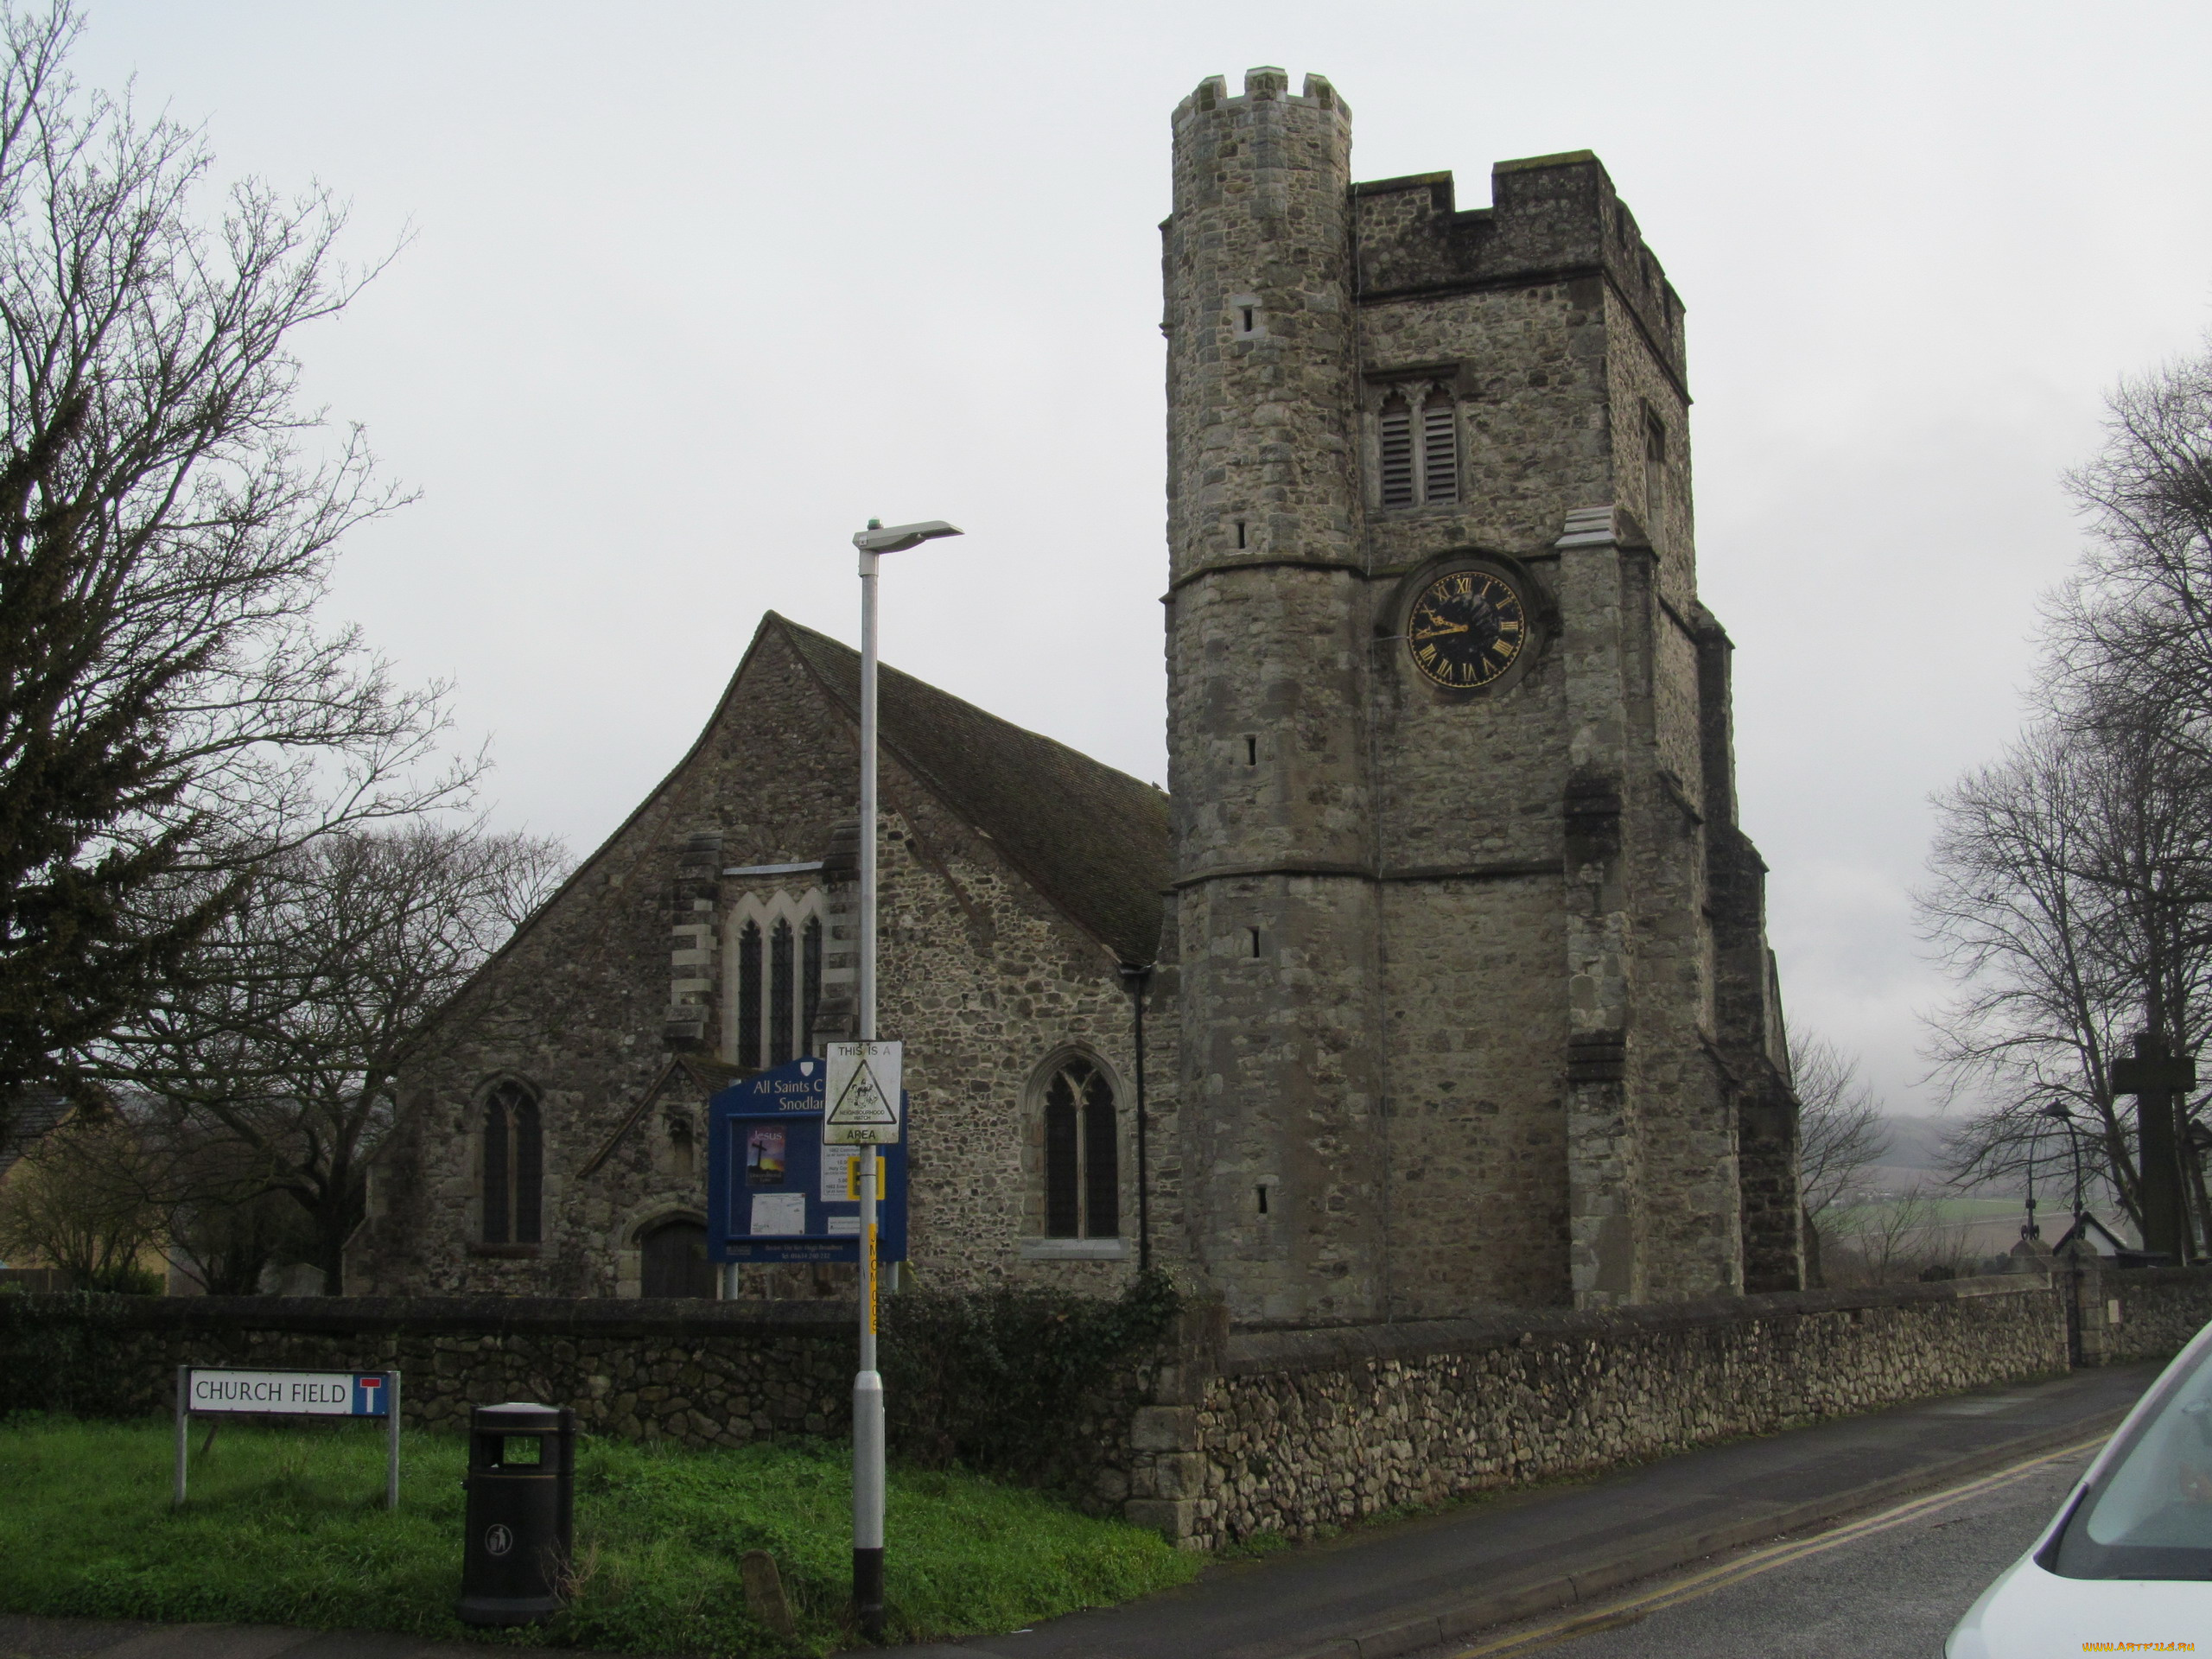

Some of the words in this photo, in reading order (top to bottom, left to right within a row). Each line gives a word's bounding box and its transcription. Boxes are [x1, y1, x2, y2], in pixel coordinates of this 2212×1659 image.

[838, 1046, 862, 1056] THIS
[868, 1046, 878, 1055] IS
[882, 1046, 891, 1055] A
[753, 1079, 771, 1094] All
[774, 1080, 810, 1094] Saints
[753, 1130, 783, 1141] Jesus
[847, 1129, 876, 1140] AREA
[196, 1381, 283, 1402] CHURCH
[291, 1382, 346, 1403] FIELD
